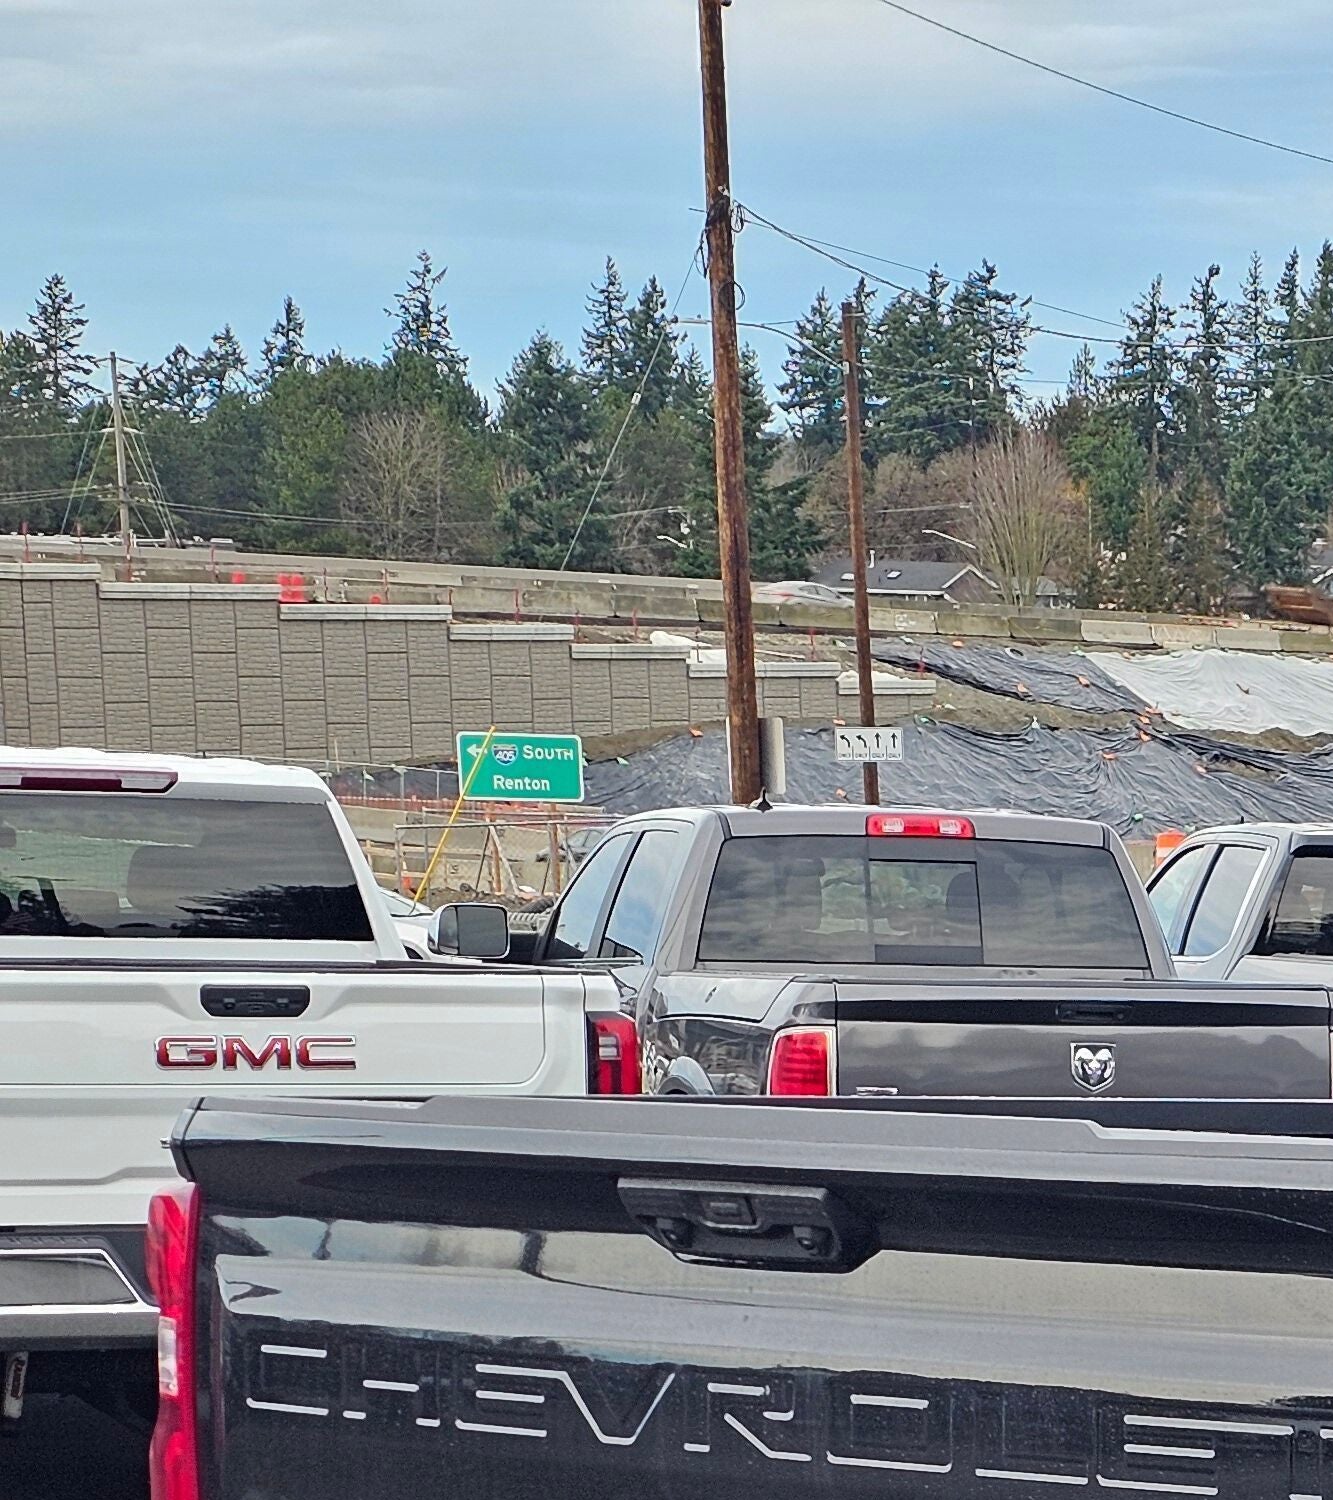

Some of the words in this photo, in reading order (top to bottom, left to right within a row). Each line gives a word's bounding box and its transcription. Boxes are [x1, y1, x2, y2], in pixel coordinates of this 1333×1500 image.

[495, 750, 515, 761] 405
[522, 744, 574, 761] SOUTH
[493, 774, 551, 791] Renton
[154, 1034, 357, 1071] GMC
